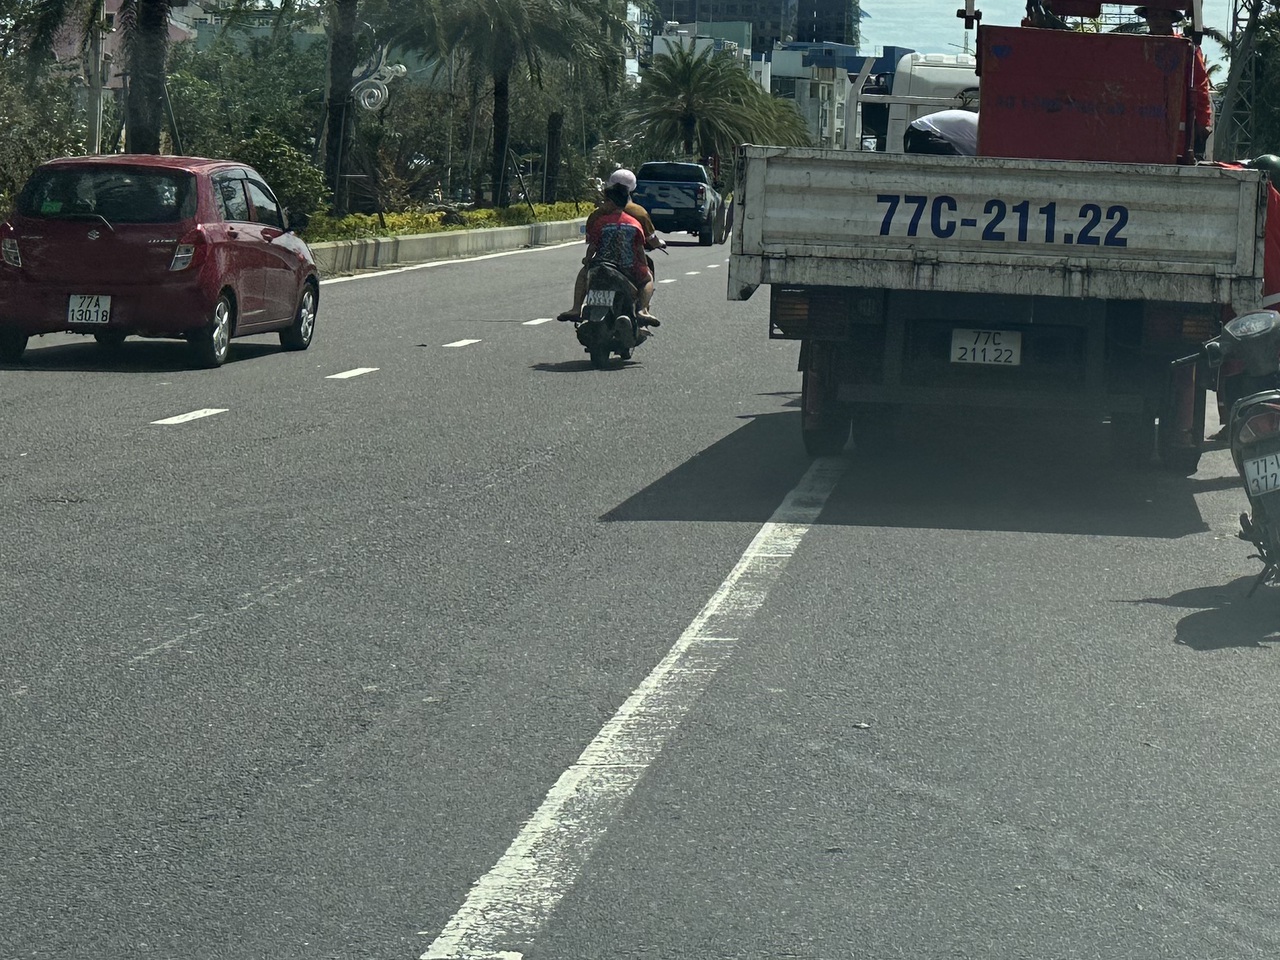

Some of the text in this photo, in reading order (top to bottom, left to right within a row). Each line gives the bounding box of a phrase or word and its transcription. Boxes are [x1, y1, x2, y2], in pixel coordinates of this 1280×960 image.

[876, 193, 1129, 248] 77C-211.22
[79, 295, 100, 309] 77A
[972, 330, 1002, 346] 77C
[957, 346, 1013, 363] 211.22
